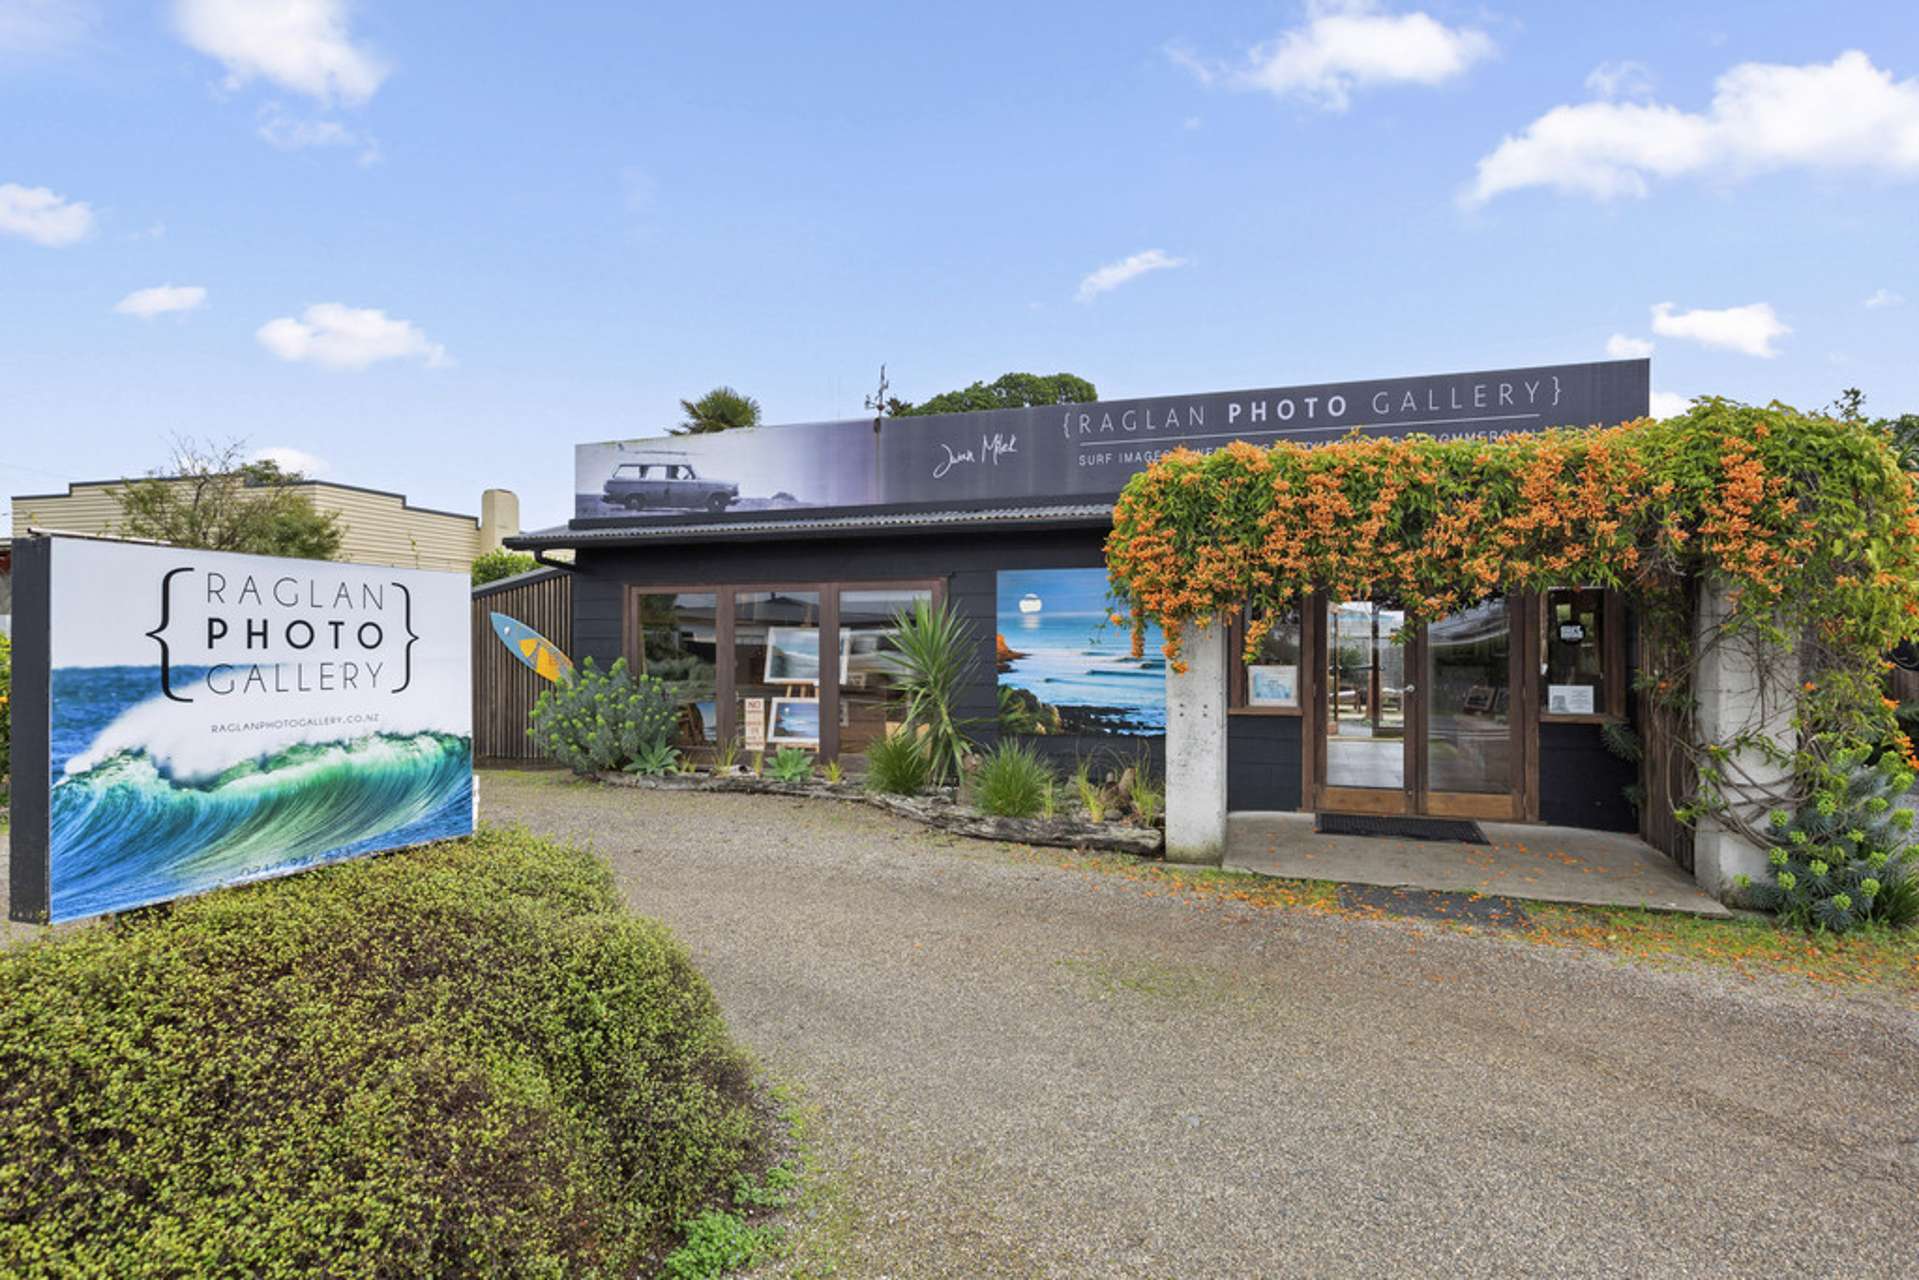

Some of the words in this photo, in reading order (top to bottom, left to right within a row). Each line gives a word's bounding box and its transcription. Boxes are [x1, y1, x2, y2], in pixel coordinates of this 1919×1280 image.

[1228, 395, 1347, 424] PHOTO
[1078, 453, 1113, 466] SURF
[207, 572, 384, 610] RAGLAN
[207, 617, 384, 650] PHOTO
[206, 661, 384, 695] GALLERY
[211, 713, 380, 733] RAGLANPHOTOGALLERY.CO.NZ
